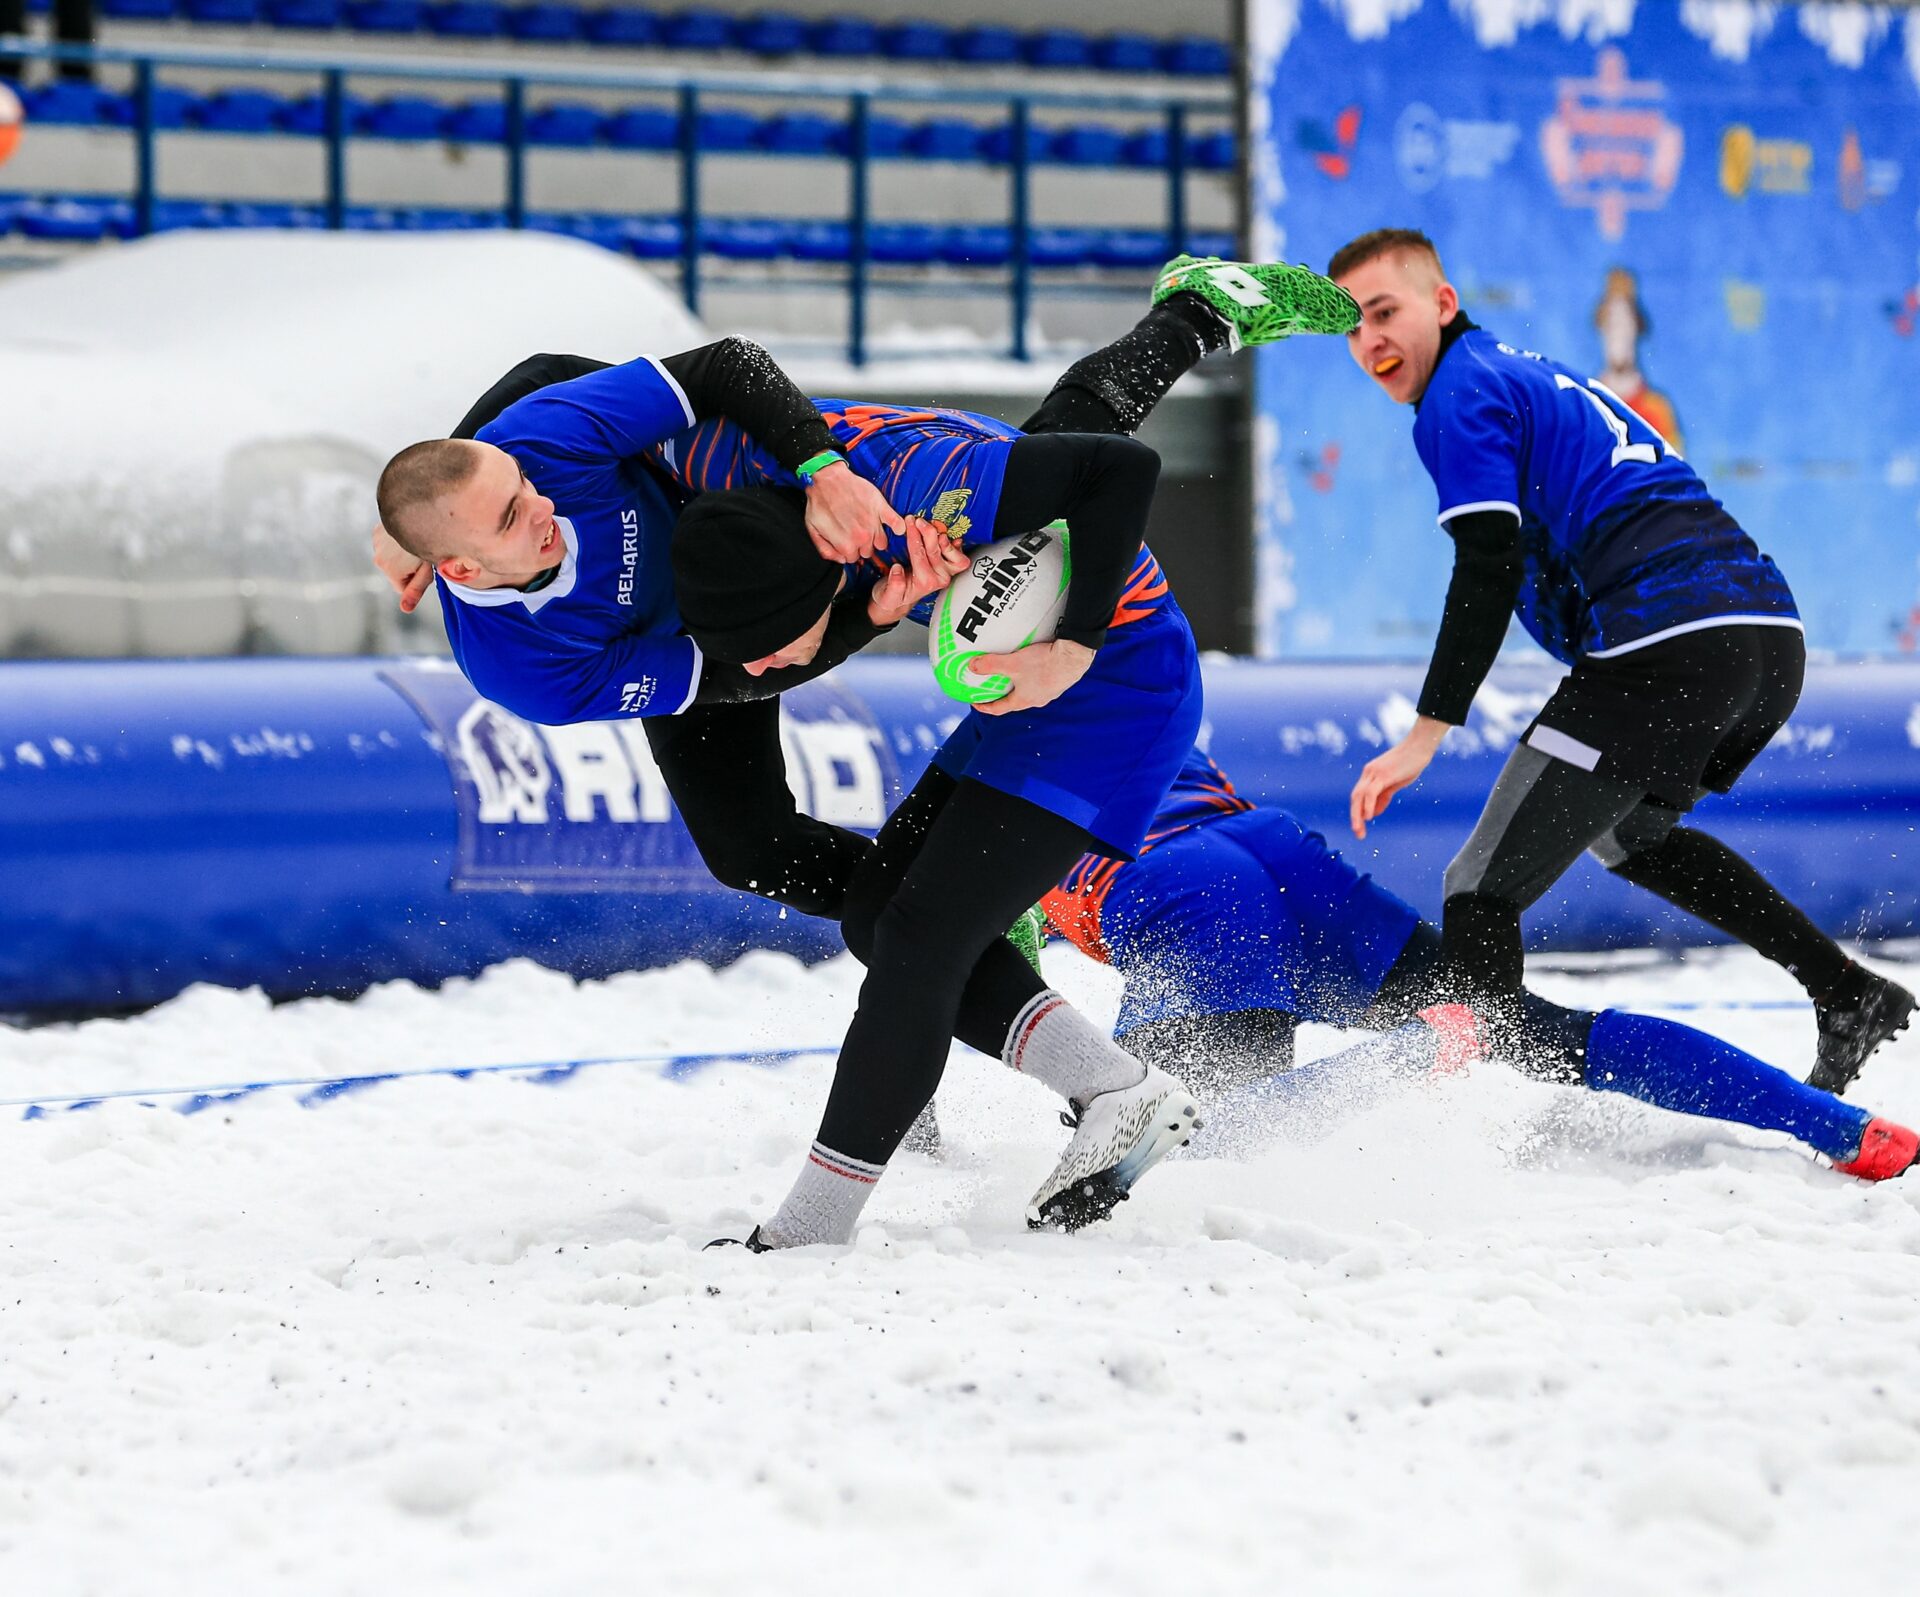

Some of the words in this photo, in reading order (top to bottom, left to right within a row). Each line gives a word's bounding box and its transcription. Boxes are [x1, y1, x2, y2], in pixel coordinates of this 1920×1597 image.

[617, 509, 638, 605] BELARUS
[956, 531, 1052, 643] RHINO
[993, 577, 1025, 617] RAPIDE
[1024, 560, 1037, 576] XV
